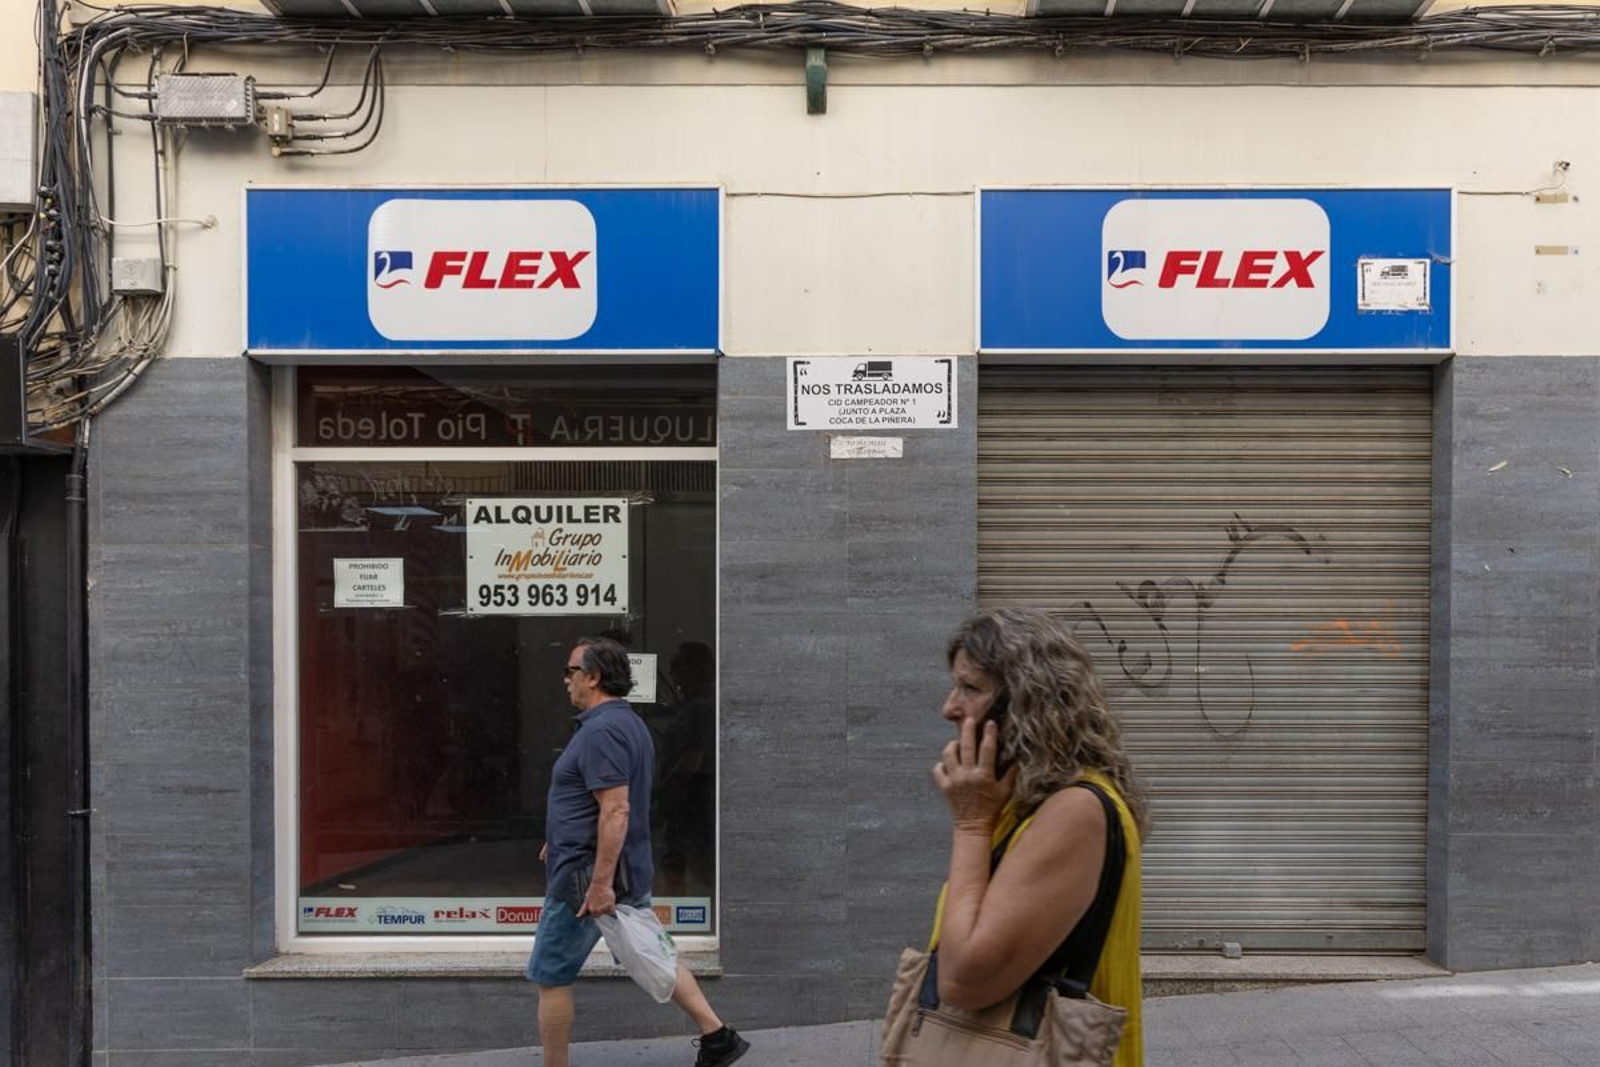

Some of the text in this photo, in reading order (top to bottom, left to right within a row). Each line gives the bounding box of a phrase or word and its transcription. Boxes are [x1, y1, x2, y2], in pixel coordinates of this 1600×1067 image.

[424, 251, 591, 289] FLEX
[1158, 250, 1325, 288] FLEX
[801, 383, 943, 395] NOS TRASLADAMOS
[829, 417, 854, 425] COCA
[855, 417, 867, 425] DE
[838, 408, 869, 416] (JUNTO
[879, 407, 907, 415] PLAZA
[473, 504, 622, 525] ALQUILER
[548, 528, 603, 550] Grupo
[478, 583, 617, 607] 953 963 914
[315, 906, 358, 918] FLEX
[377, 914, 425, 925] TEMPUR
[434, 906, 491, 919] relax
